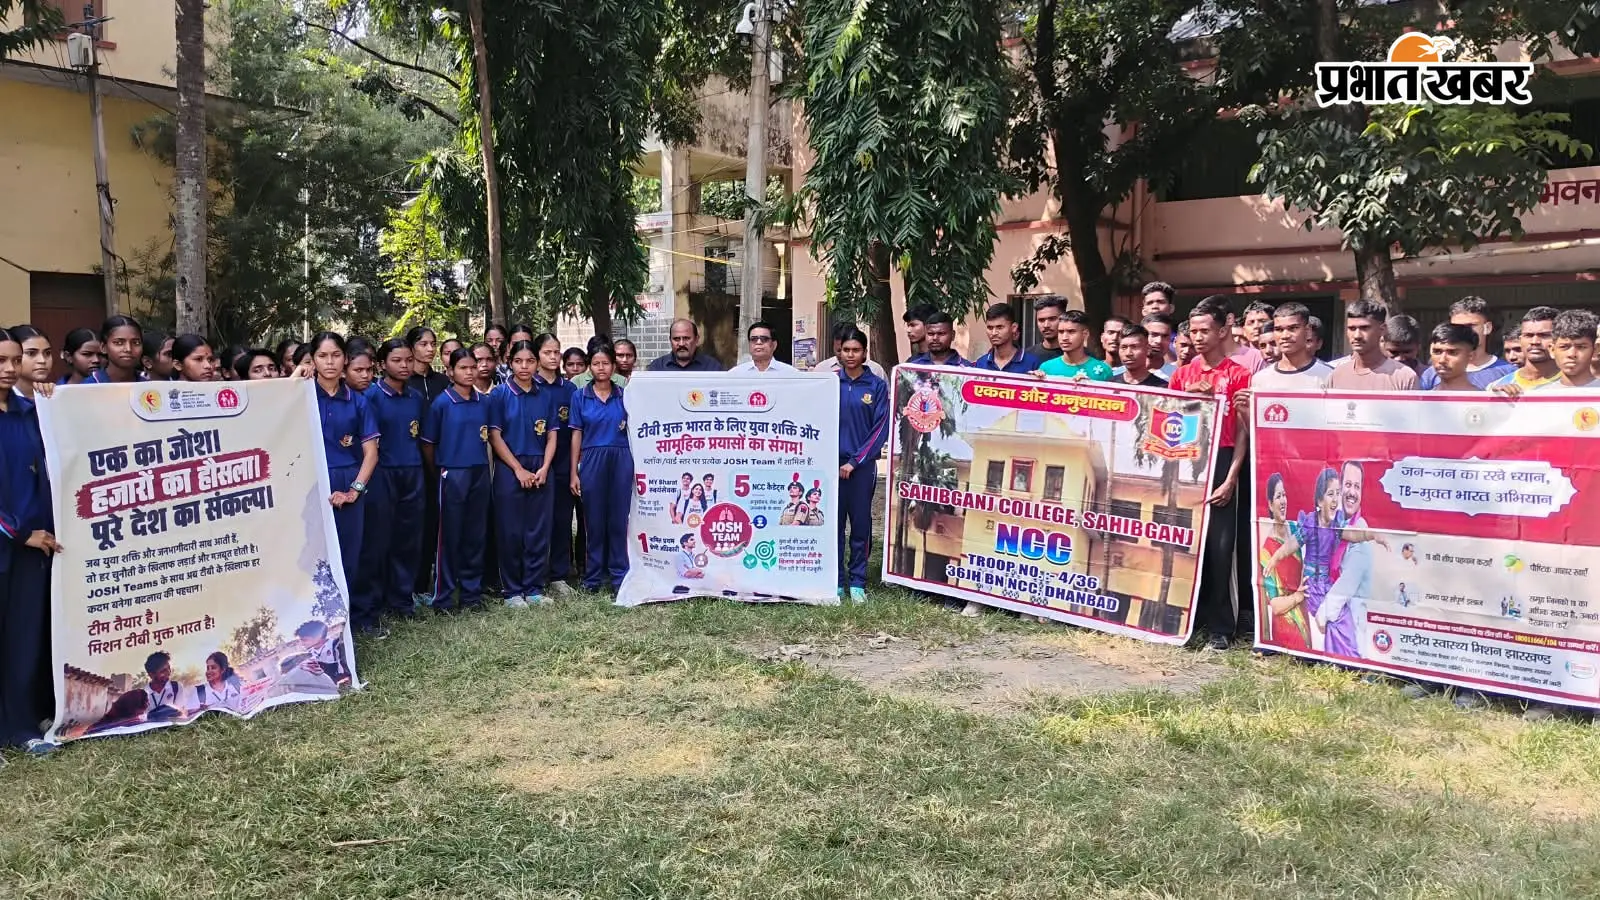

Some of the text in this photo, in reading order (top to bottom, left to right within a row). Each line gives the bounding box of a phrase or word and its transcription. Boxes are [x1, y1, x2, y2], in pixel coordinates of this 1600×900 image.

[974, 384, 1127, 414] एकता और अनुशासन
[663, 422, 683, 438] मुक्त
[686, 420, 712, 432] भारत
[714, 417, 724, 432] के
[726, 417, 747, 432] लिए
[749, 422, 770, 436] युवा
[772, 420, 798, 436] शक्ति
[800, 424, 820, 440] और
[88, 428, 221, 477] एक का जोश।
[656, 433, 802, 456] सामूहिक प्रयासों का संगम!
[90, 454, 261, 514] हजारों का हौसला।
[636, 474, 646, 496] 5
[734, 474, 750, 497] 5
[1401, 466, 1457, 480] जन-जन
[1460, 470, 1480, 480] का
[1456, 490, 1490, 502] भारत
[1494, 489, 1552, 506] अभियान
[91, 485, 274, 551] पूरे देश का संकल्प।
[709, 522, 742, 532] JOSH
[899, 482, 1194, 547] SAHIBGANJ COLLEGE, SAHIBGANJ
[85, 558, 100, 568] जब
[103, 556, 120, 568] युवा
[122, 550, 141, 563] शक्ति
[142, 547, 156, 559] और
[157, 540, 197, 556] जनभागीदारी
[198, 540, 212, 549] साथ
[214, 534, 230, 546] आती
[638, 532, 648, 553] 1
[712, 532, 740, 542] TEAM
[994, 523, 1073, 565] NCC
[85, 572, 96, 583] तो
[99, 573, 110, 582] हर
[112, 566, 136, 582] चुनौती
[138, 564, 146, 574] के
[148, 560, 176, 572] खिलाफ
[198, 552, 210, 562] और
[234, 544, 248, 556] होती
[88, 586, 120, 598] JOSH
[123, 580, 158, 592] Teams
[160, 575, 168, 584] के
[170, 572, 184, 583] साथ
[187, 570, 198, 580] अब
[216, 564, 224, 573] के
[251, 558, 260, 567] हर
[968, 553, 1016, 572] TROOP
[1058, 571, 1098, 589] 4/36
[87, 602, 110, 614] कदम
[112, 598, 132, 608] बनेगा
[134, 593, 162, 604] बदलाव
[164, 587, 174, 598] की
[984, 572, 1004, 586] BN
[1045, 586, 1118, 611] DHANBAD
[88, 620, 110, 636] टीम
[113, 615, 142, 631] तैयार
[88, 614, 216, 656] मिशन टीबी मुक्त भारत है!
[1400, 633, 1430, 646] राष्ट्रीय
[1432, 638, 1468, 652] स्वास्थ्य
[1471, 640, 1502, 656] मिशन
[1505, 648, 1552, 664] झारखण्ड
